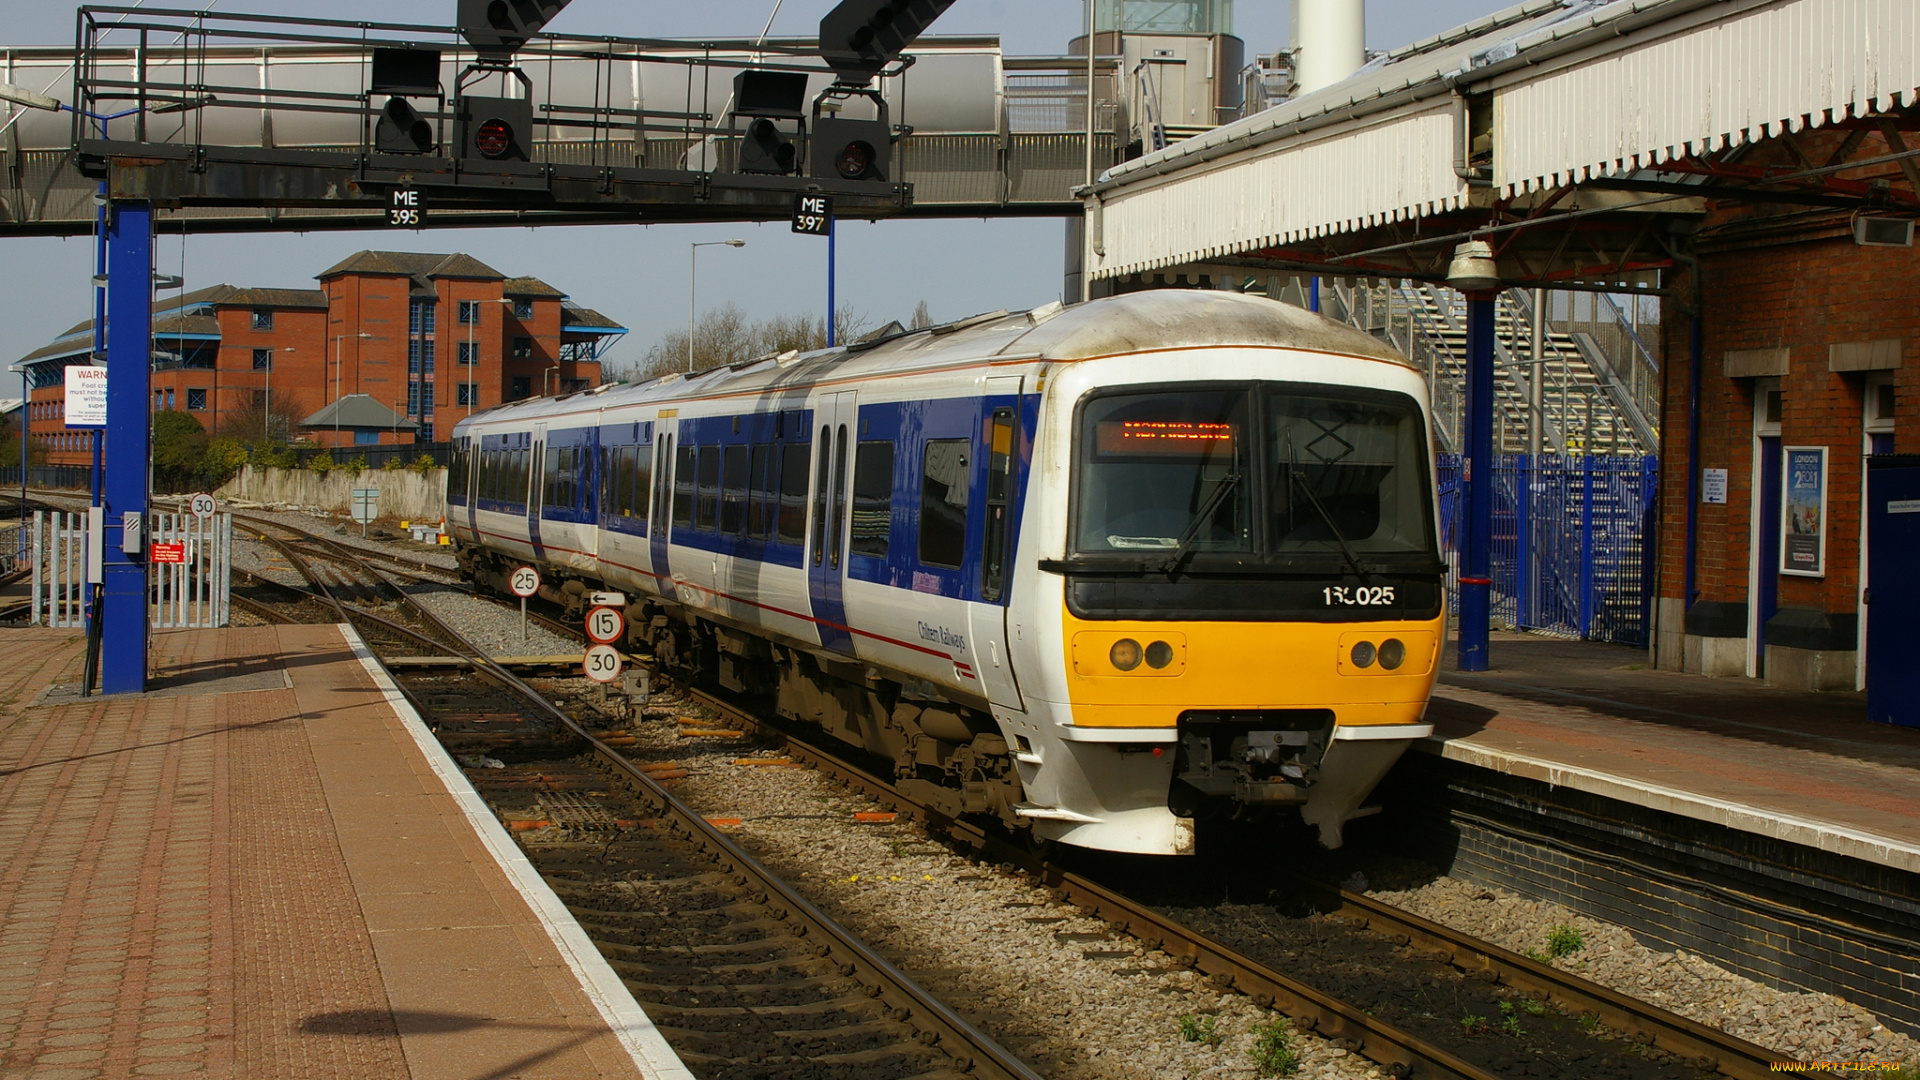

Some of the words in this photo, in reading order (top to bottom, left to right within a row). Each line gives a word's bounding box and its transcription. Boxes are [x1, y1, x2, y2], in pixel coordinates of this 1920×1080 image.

[394, 191, 418, 205] ME
[802, 197, 825, 213] ME
[391, 209, 419, 224] 395
[796, 215, 824, 231] 397
[77, 370, 107, 379] WARN
[1795, 455, 1818, 463] LONDON
[196, 500, 212, 512] 30
[515, 573, 534, 589] 25
[596, 614, 613, 634] 15
[918, 621, 940, 643] Chiltern
[939, 625, 965, 653] Railways
[591, 654, 615, 671] 30
